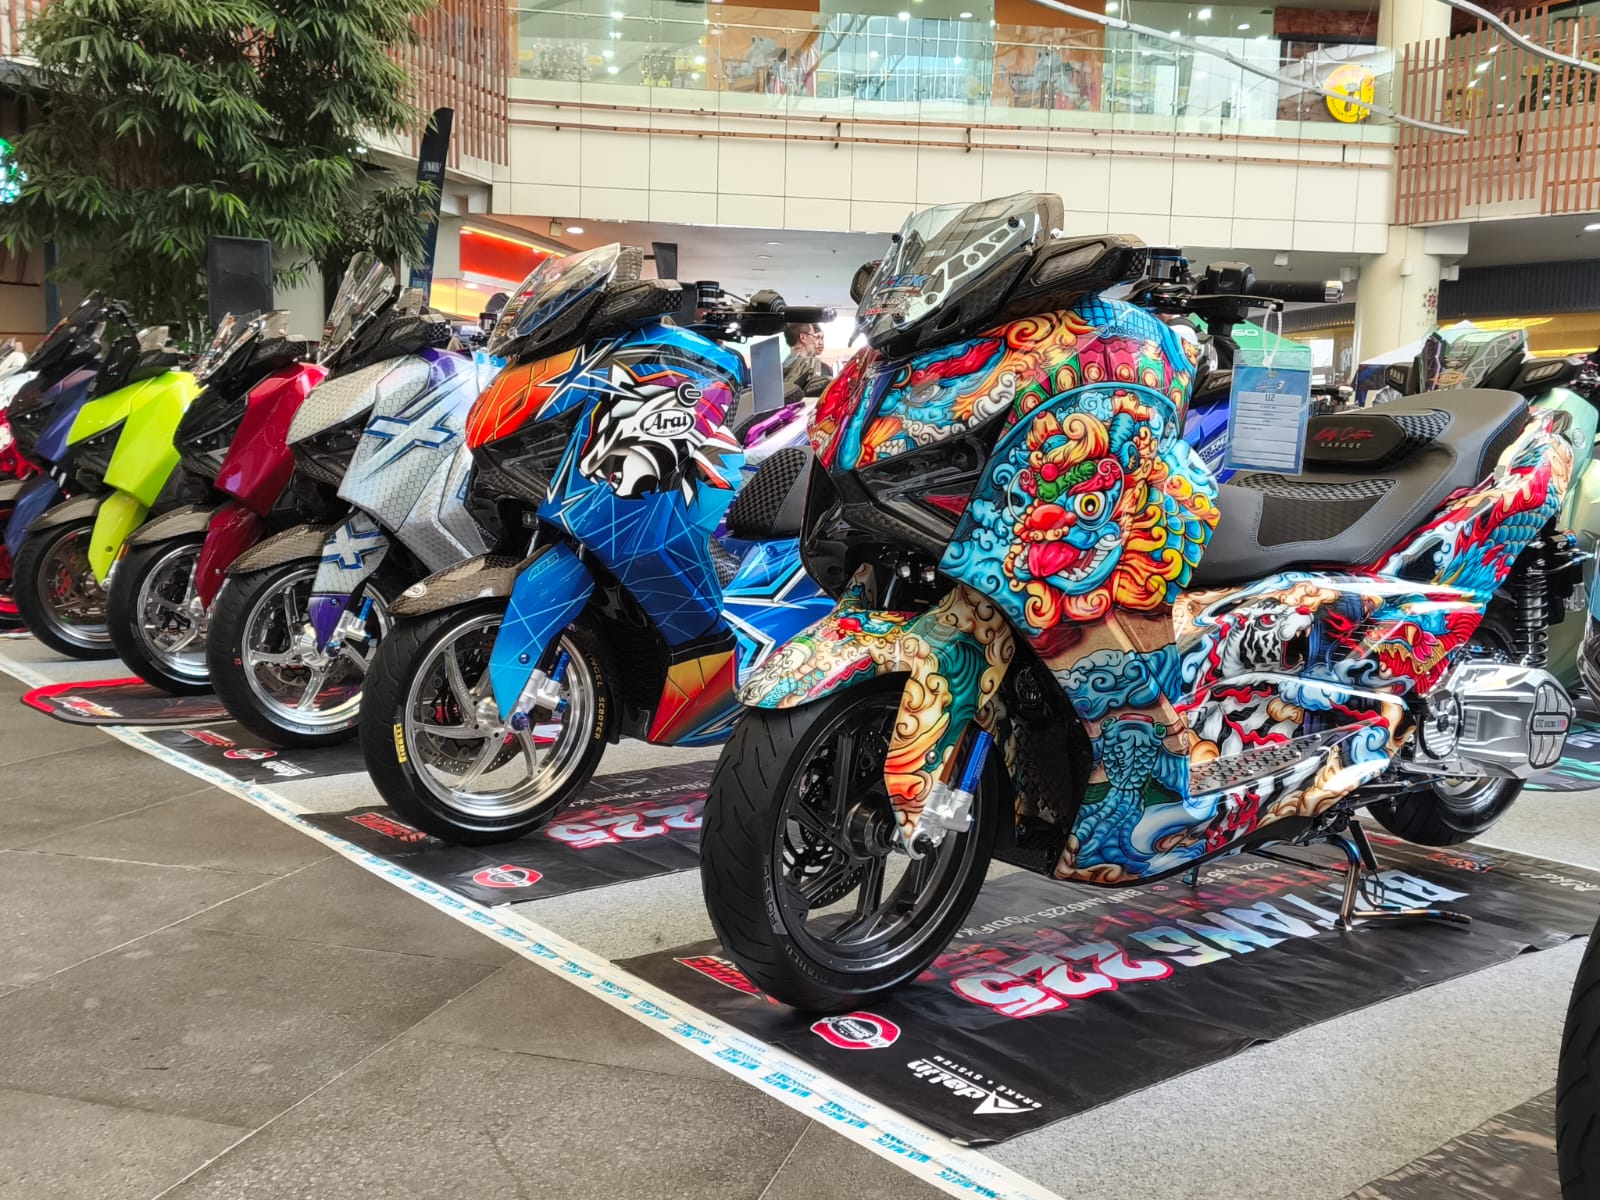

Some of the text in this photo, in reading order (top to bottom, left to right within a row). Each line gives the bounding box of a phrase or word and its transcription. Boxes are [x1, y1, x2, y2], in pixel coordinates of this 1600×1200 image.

[645, 412, 688, 432] Arai
[594, 696, 605, 740] SCOOTER
[950, 940, 1174, 1019] 225
[933, 1055, 1043, 1109] BRAKE SYSTEM
